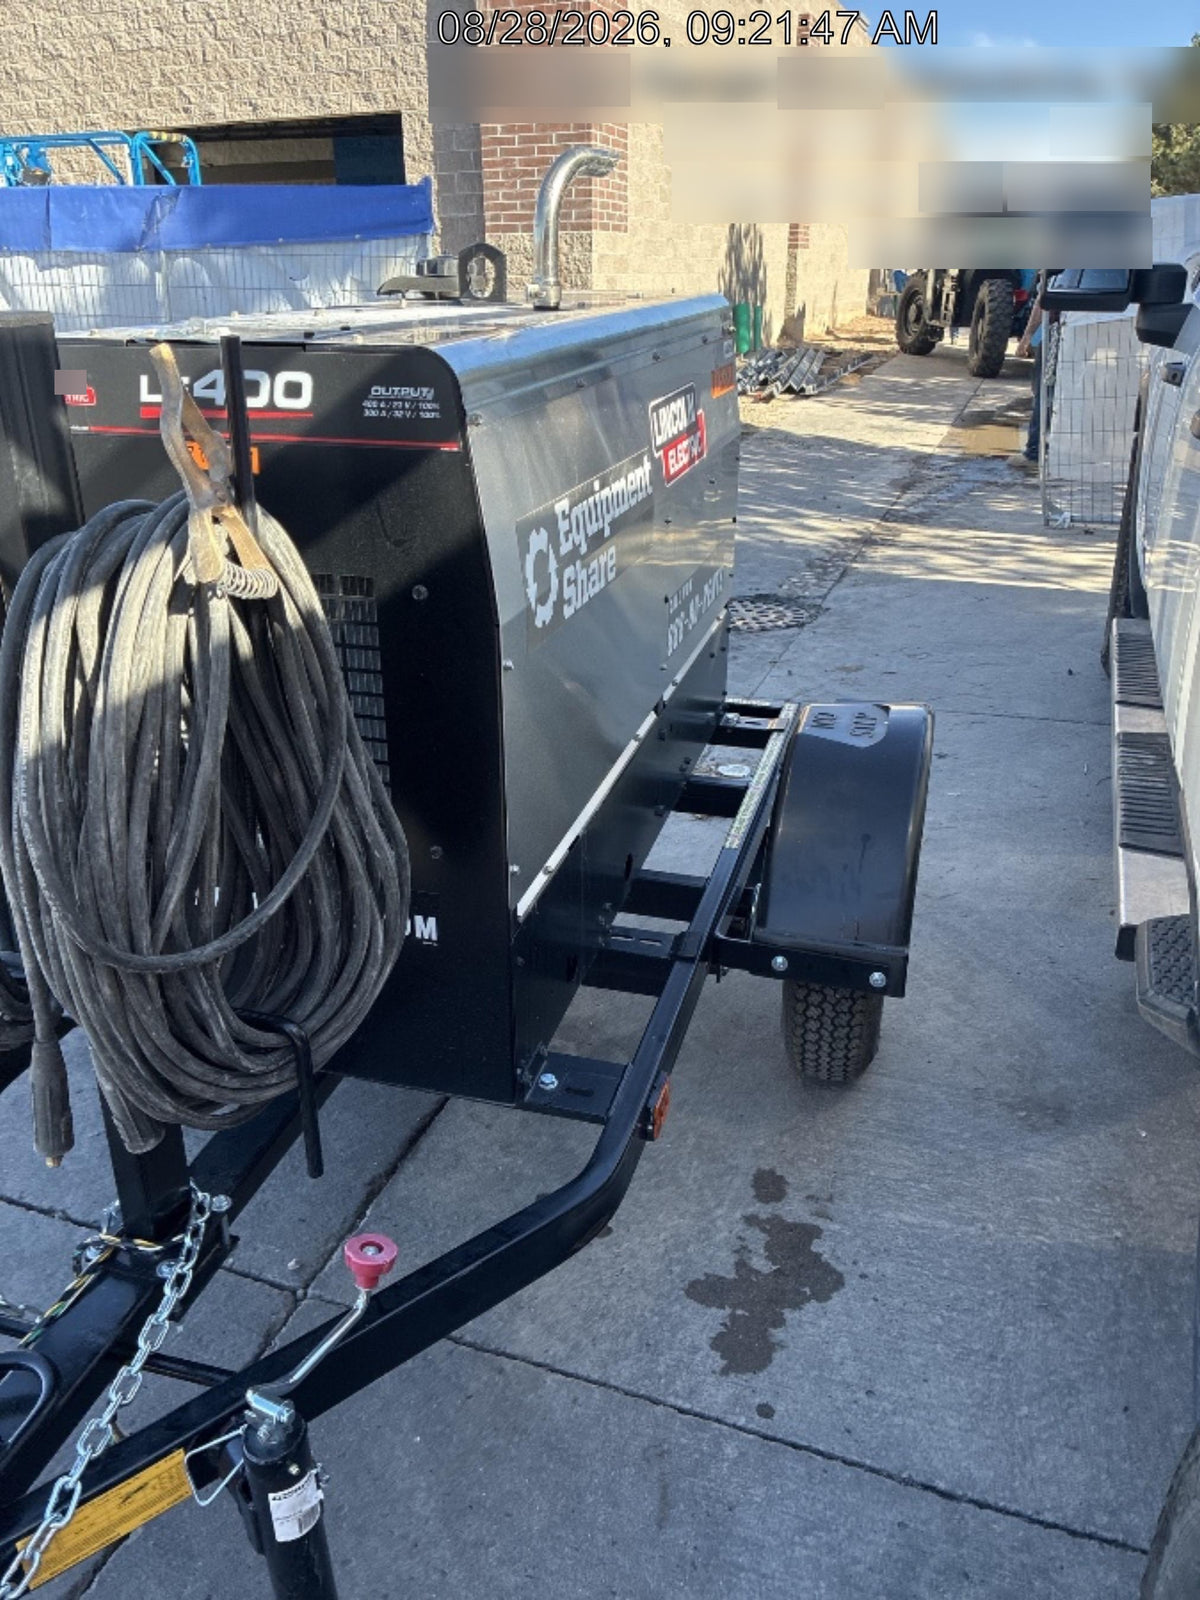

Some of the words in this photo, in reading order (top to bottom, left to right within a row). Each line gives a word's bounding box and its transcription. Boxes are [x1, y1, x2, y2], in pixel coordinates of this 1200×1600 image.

[371, 385, 430, 397] OUTPUT
[555, 453, 653, 555] Equipment
[563, 544, 617, 620] Share
